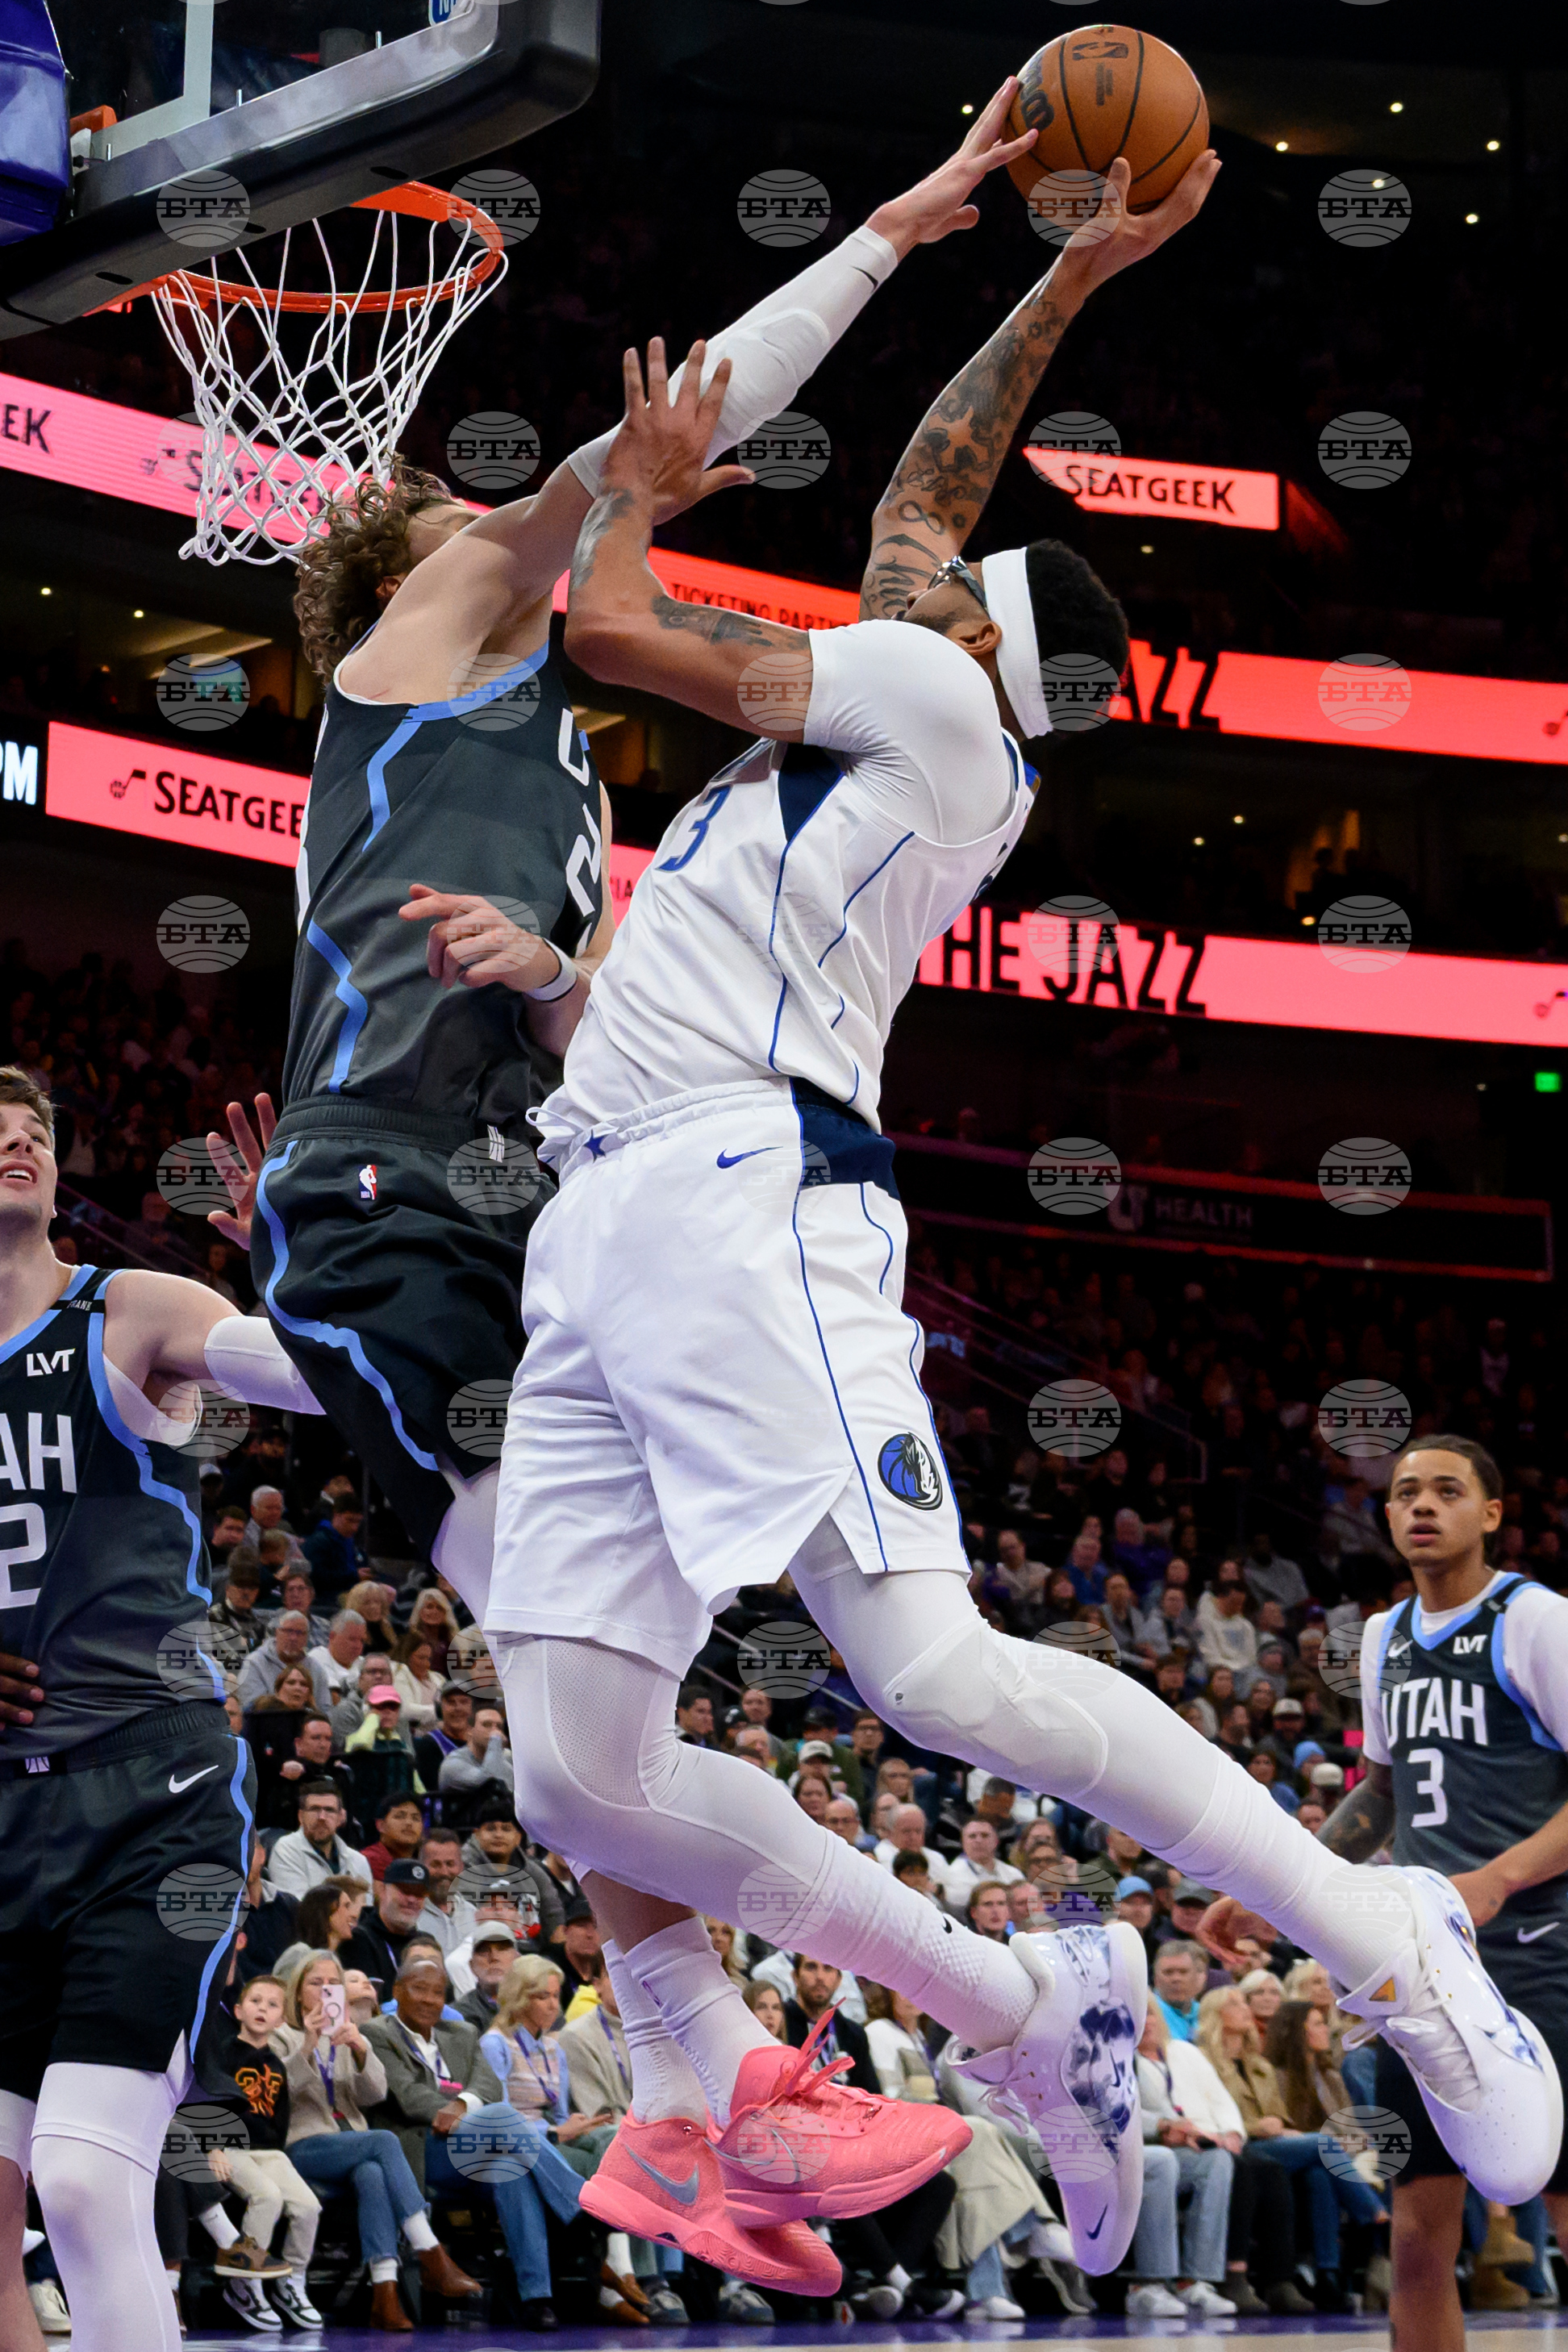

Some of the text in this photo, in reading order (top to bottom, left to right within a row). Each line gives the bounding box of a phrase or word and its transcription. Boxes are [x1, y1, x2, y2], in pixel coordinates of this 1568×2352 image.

[1065, 465, 1235, 515] SEATGEEK
[0, 740, 38, 806] M
[655, 784, 733, 873] 3
[936, 902, 1207, 1015] HE JAZZ
[1154, 1197, 1254, 1228] HEALTH
[26, 1348, 76, 1377] LVT
[1453, 1634, 1488, 1654] LVT
[1381, 1677, 1488, 1746] UTAH
[1407, 1748, 1449, 1828] 3
